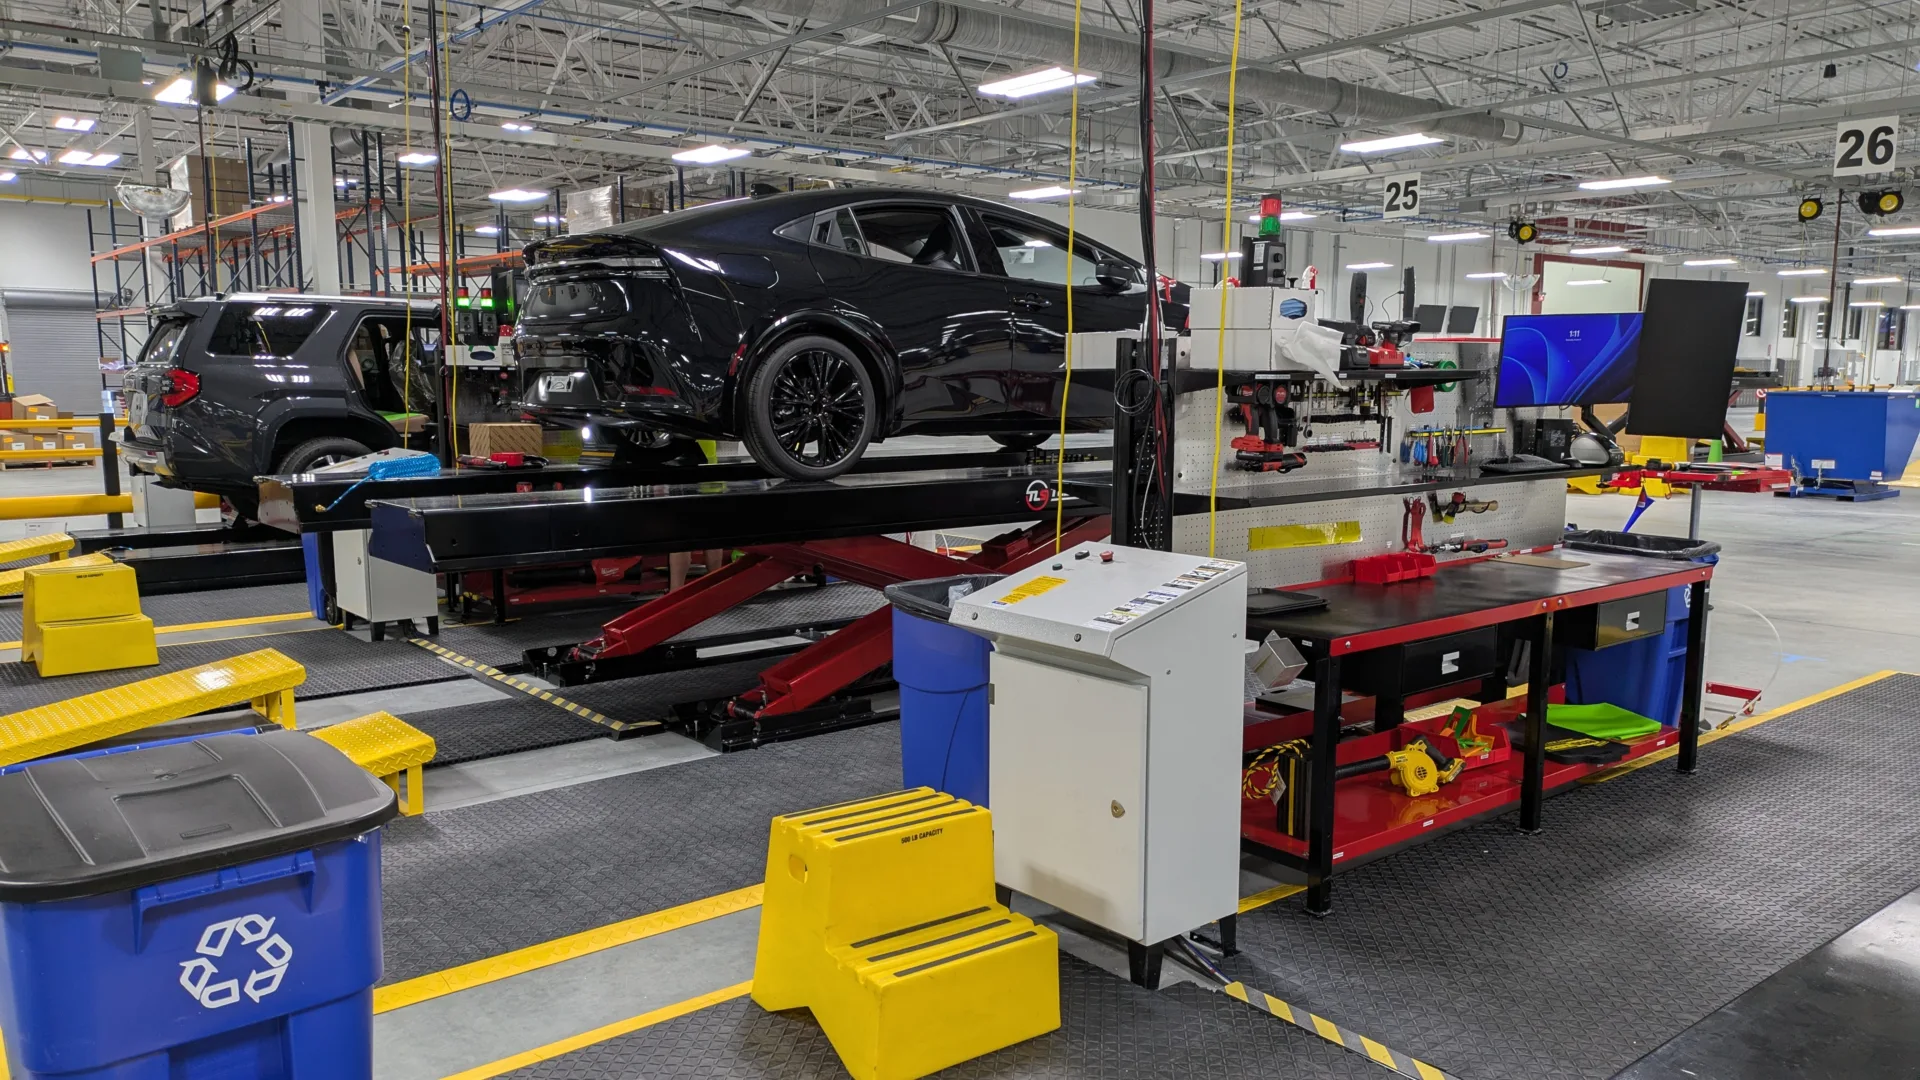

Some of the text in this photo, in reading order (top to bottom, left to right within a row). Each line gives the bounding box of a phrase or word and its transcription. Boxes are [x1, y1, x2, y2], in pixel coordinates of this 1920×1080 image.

[1836, 125, 1895, 168] 26
[1384, 179, 1418, 212] 25
[1569, 330, 1580, 338] 1:11
[1026, 489, 1049, 502] TLS
[901, 828, 944, 844] 500 LB CAPACITY
